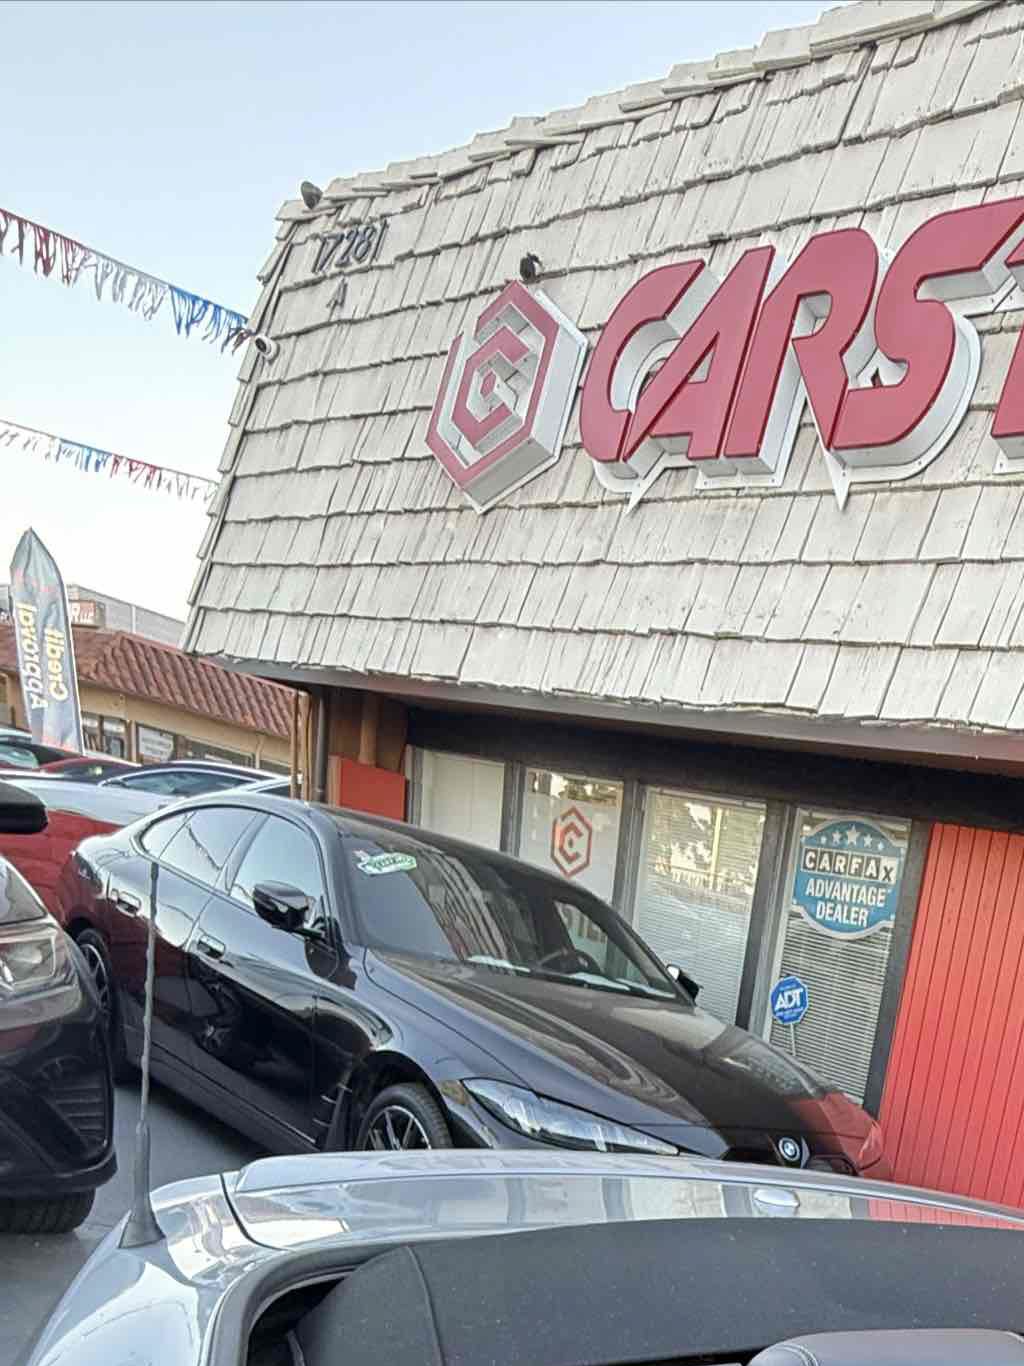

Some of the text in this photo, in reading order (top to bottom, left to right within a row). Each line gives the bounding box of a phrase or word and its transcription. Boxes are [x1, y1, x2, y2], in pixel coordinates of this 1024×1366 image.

[804, 850, 895, 882] CARFAX
[806, 878, 886, 908] ADVANTAGE
[816, 901, 868, 927] DEALER
[774, 989, 803, 1011] ADT
